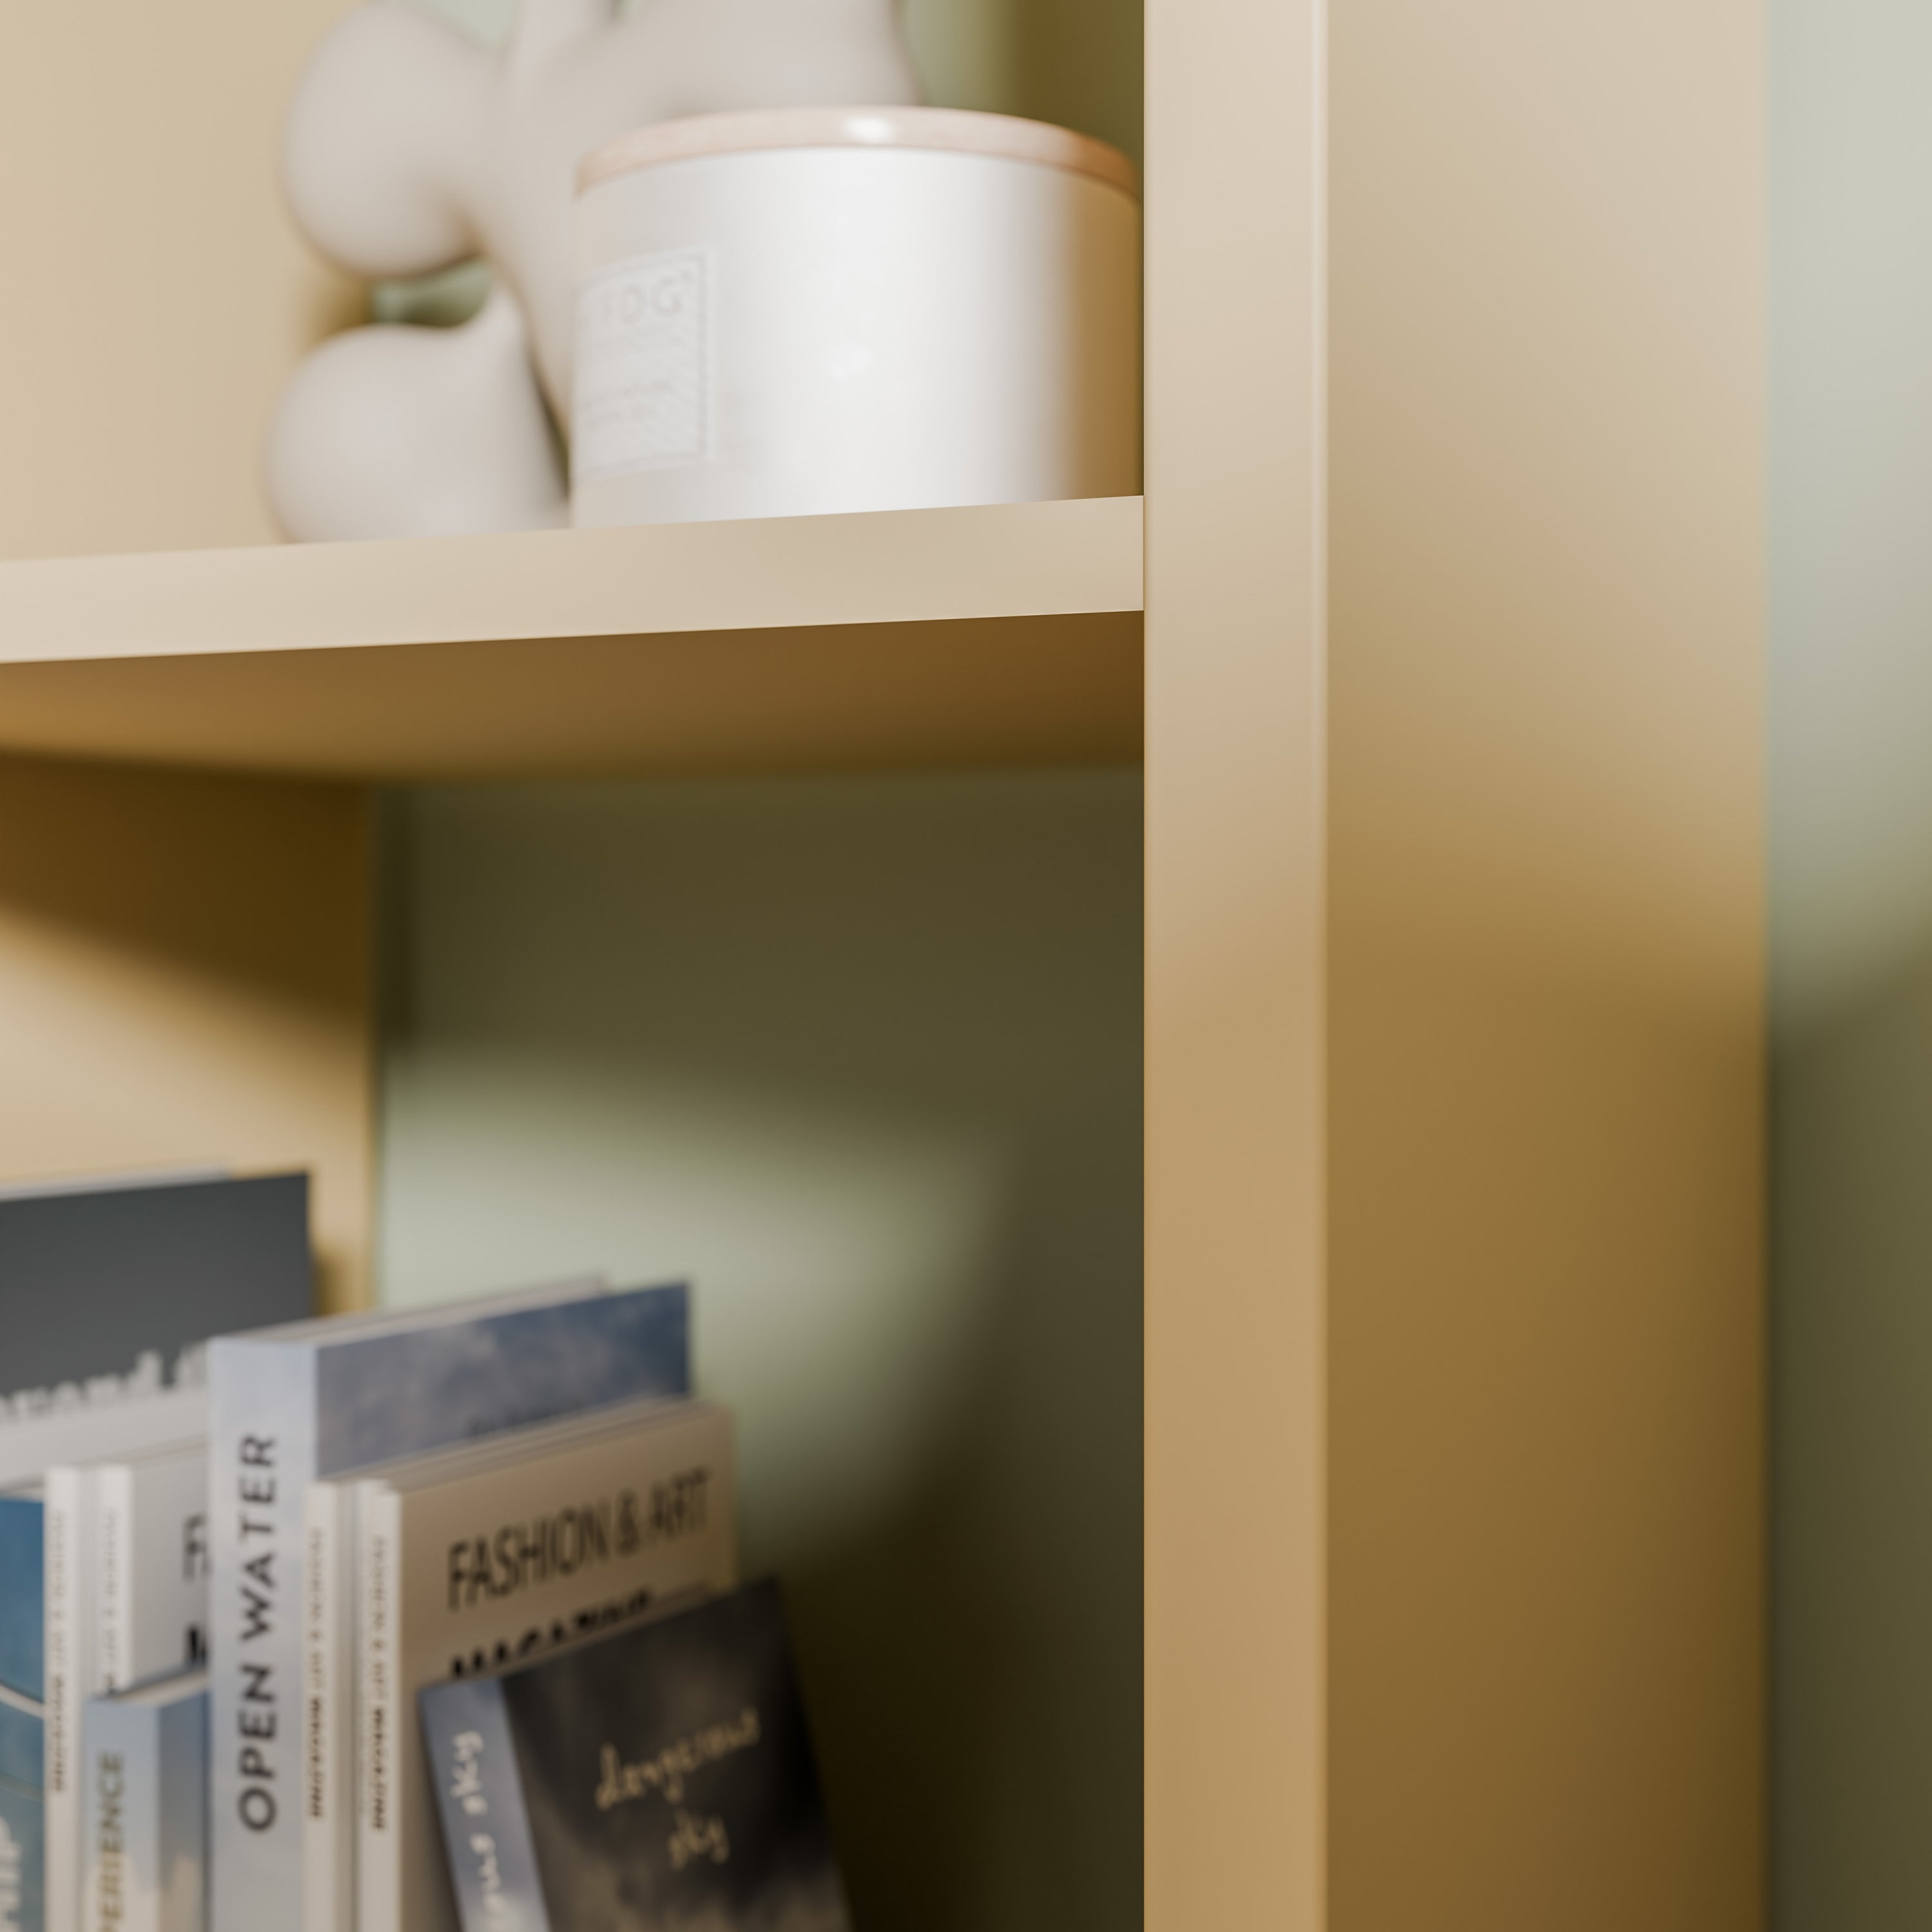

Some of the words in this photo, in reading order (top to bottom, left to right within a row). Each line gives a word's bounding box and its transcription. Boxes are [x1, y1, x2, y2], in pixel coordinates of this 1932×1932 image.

[238, 1434, 277, 1643] WATER
[446, 1498, 611, 1613] FASHION
[614, 1488, 641, 1556] &
[647, 1464, 712, 1544] ART
[238, 1663, 277, 1834] OPEN
